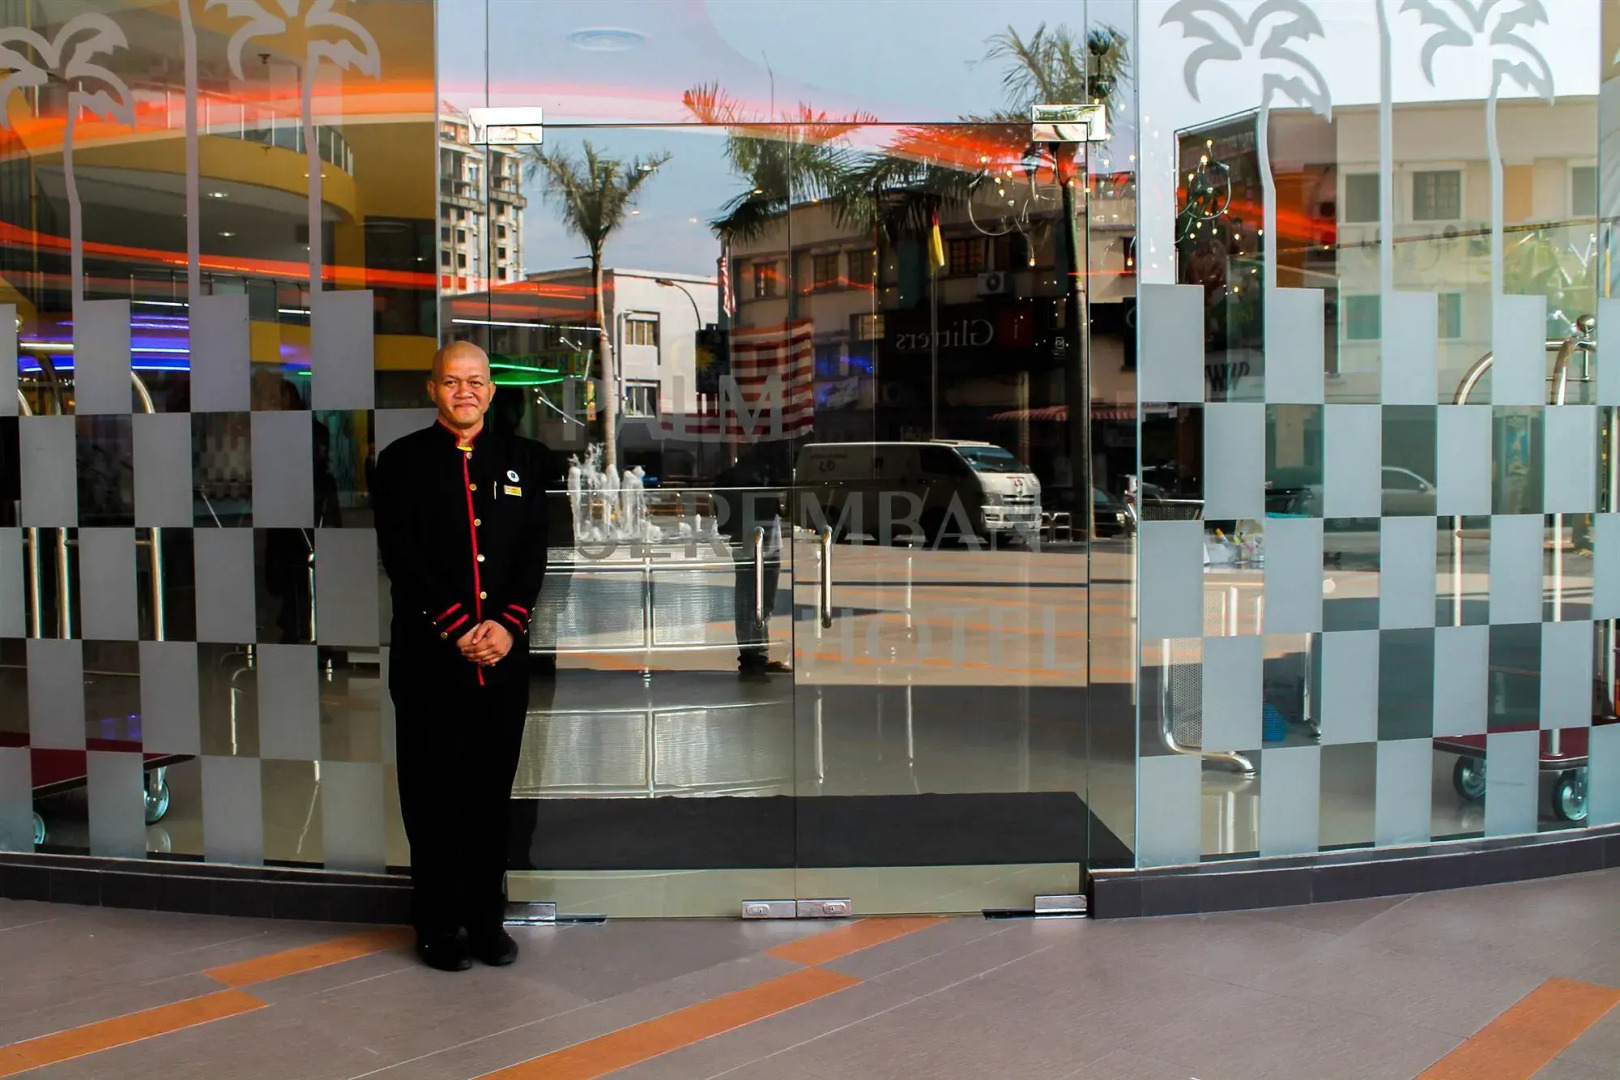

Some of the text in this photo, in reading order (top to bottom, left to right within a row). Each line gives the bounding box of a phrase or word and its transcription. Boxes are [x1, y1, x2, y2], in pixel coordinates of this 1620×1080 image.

[562, 374, 783, 443] PALM
[574, 489, 1041, 560] REMBAN
[801, 606, 1081, 670] HOTEL
